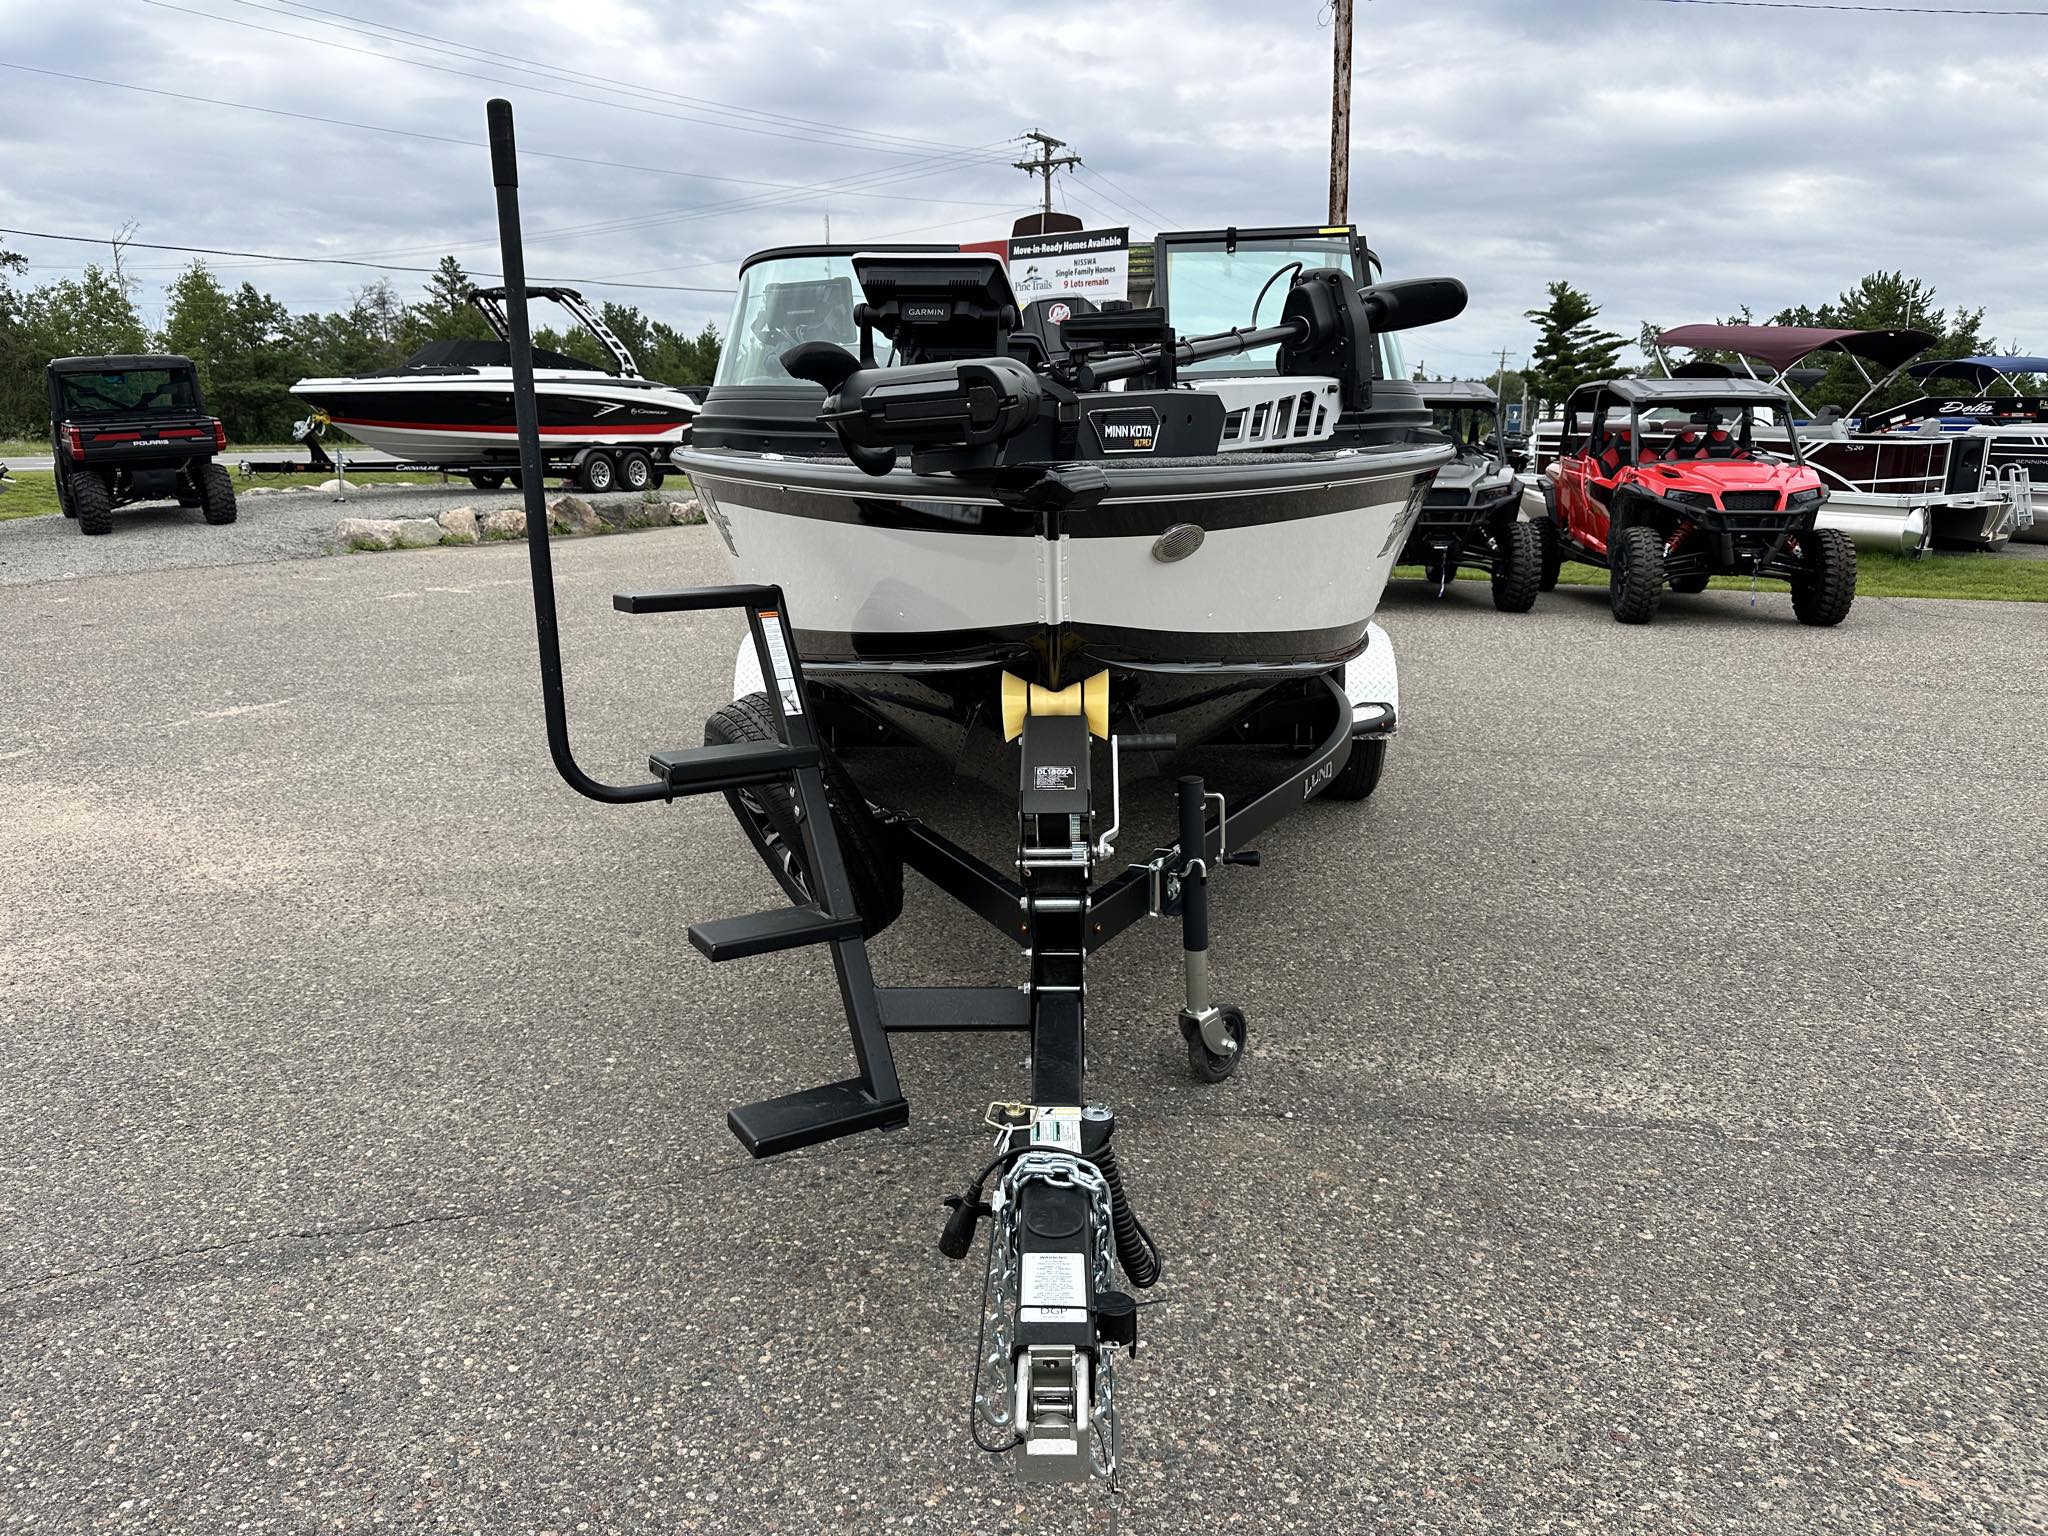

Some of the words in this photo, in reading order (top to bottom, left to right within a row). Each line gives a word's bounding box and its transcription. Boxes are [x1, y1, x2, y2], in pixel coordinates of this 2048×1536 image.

[1013, 242, 1063, 256] Move-in-Ready
[1063, 240, 1088, 250] Homes
[1088, 236, 1122, 248] Available
[1073, 257, 1097, 267] NISSWA
[1055, 268, 1074, 279] Single
[1074, 267, 1094, 277] Family
[1094, 266, 1116, 274] Homes
[1014, 281, 1032, 292] Pine
[1032, 279, 1053, 292] Trails
[1063, 280, 1069, 289] 9
[1070, 279, 1084, 288] Lots
[1085, 277, 1109, 287] remain
[908, 308, 944, 316] GARMIN
[1938, 401, 1994, 413] Delta
[1104, 425, 1129, 438] MINN
[1129, 425, 1153, 438] KOTA
[132, 439, 170, 447] POLARIS
[1133, 438, 1152, 447] ULTREX
[1845, 444, 1865, 452] S20
[1303, 760, 1333, 800] LUND
